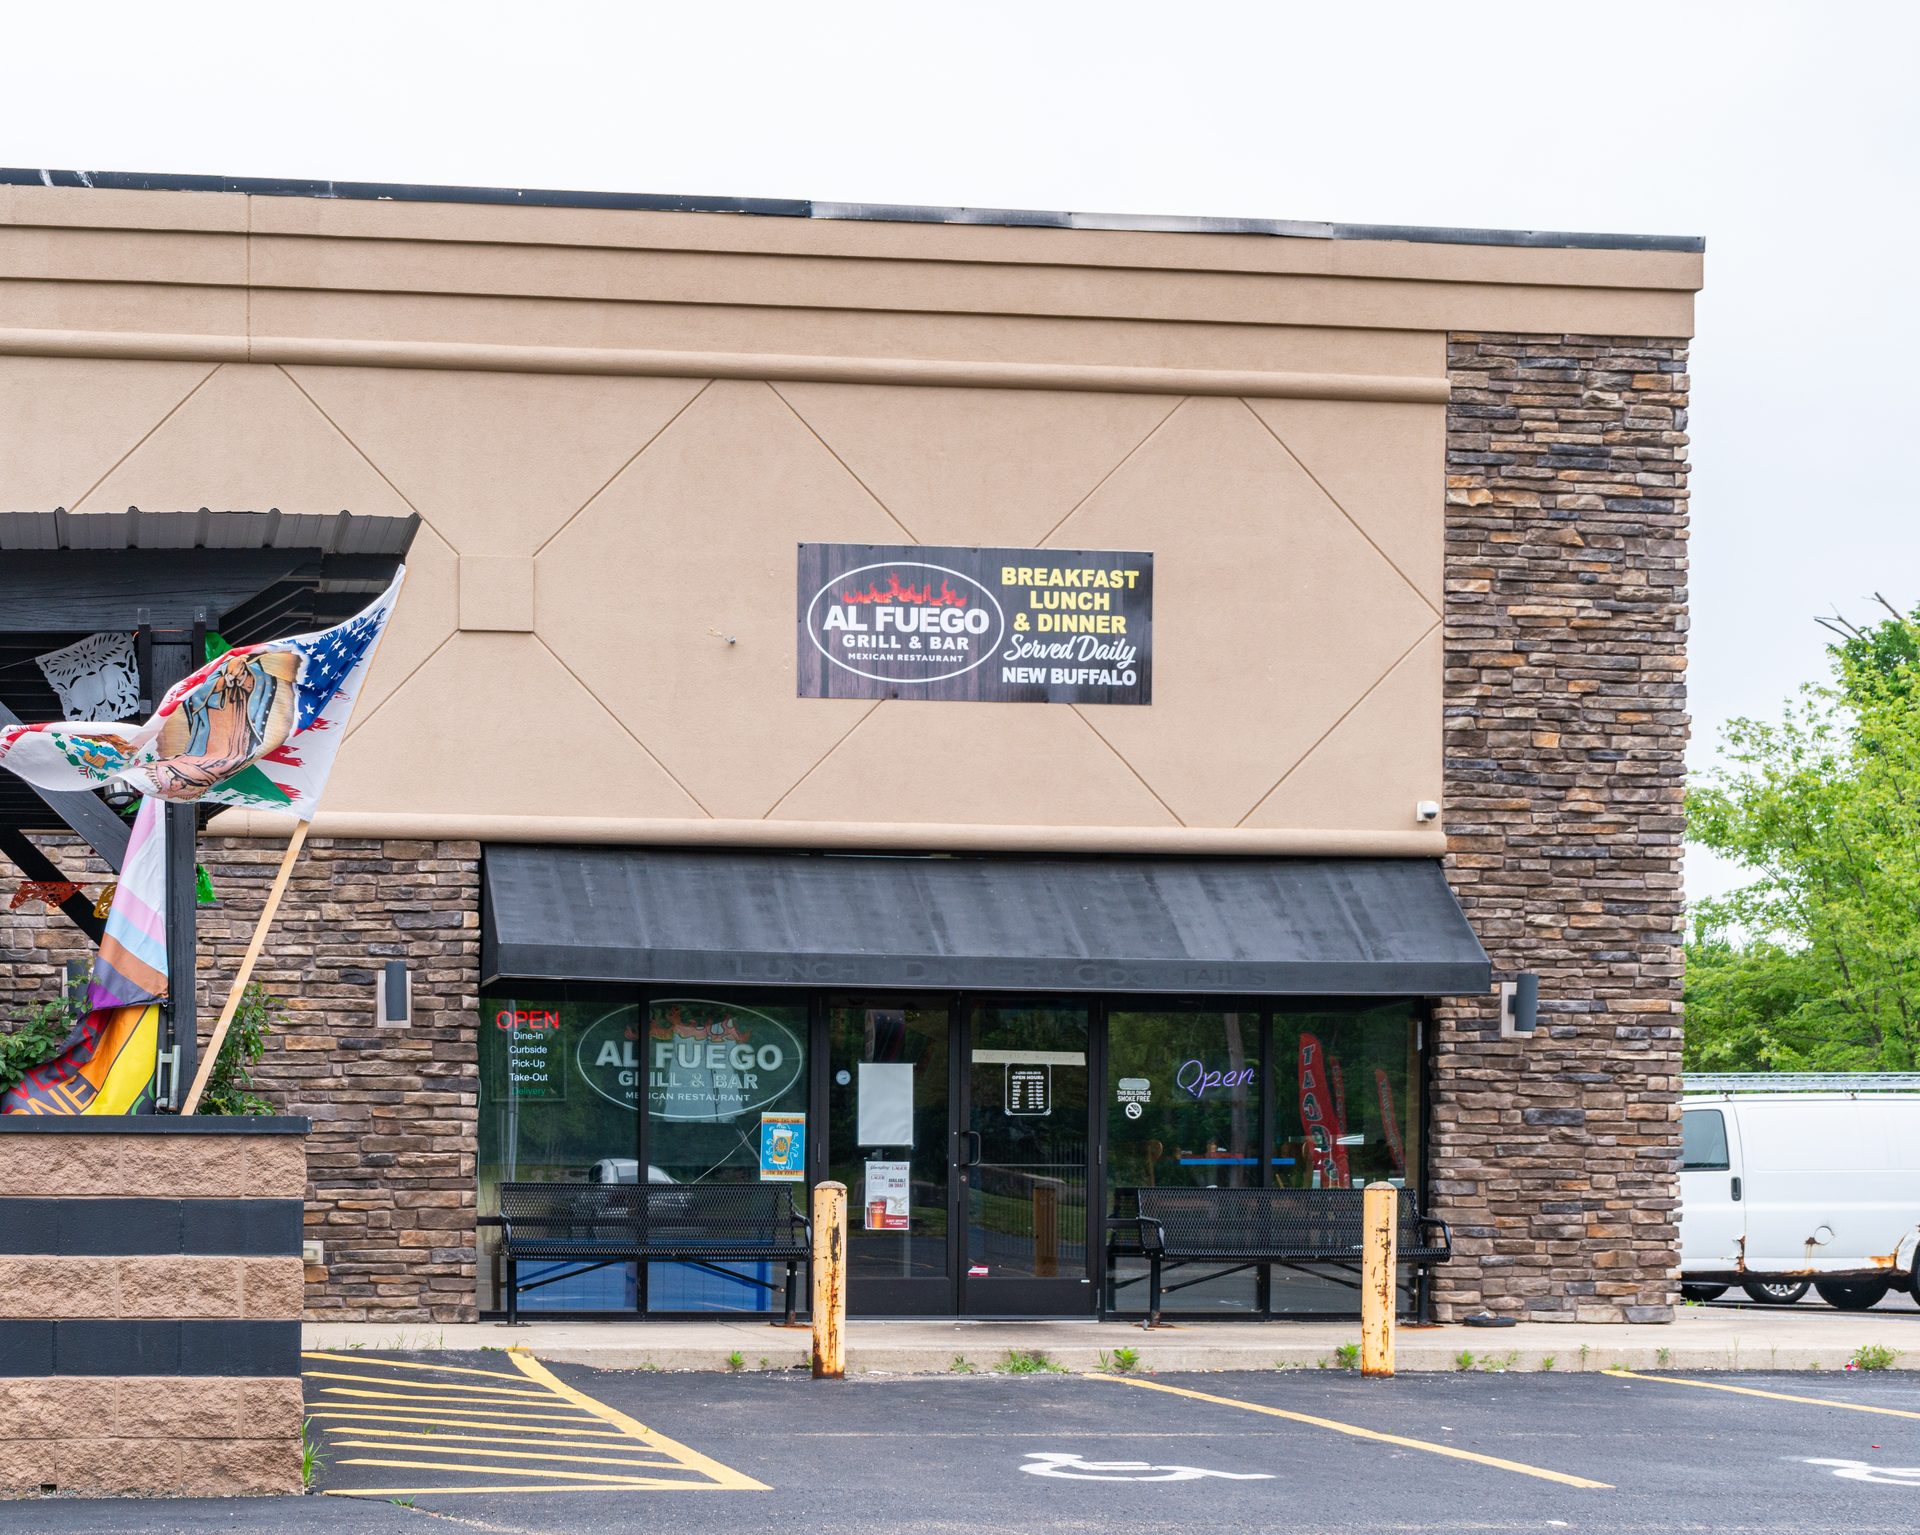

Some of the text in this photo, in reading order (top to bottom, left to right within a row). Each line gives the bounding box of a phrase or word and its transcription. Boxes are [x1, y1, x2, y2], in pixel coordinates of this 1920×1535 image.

[1001, 566, 1139, 589] BREAKFAST
[1030, 590, 1110, 611] LUNCH
[823, 605, 990, 635] AL FUEGO
[1014, 613, 1127, 634] & DINNER
[842, 634, 969, 650] GRILL & BAR
[1003, 634, 1136, 668] Served Daily
[848, 652, 964, 663] MEXICAN RESTAURANT
[1002, 667, 1137, 687] NEW BUFFALO
[736, 956, 859, 979] LUNCH
[496, 1010, 559, 1029] OPEN
[513, 1031, 544, 1040] Dine-In
[509, 1045, 548, 1054] Curbside
[595, 1040, 783, 1071] AL FUEGO
[511, 1059, 545, 1069] Pick-Up
[510, 1072, 549, 1081] Take-Out
[691, 1072, 705, 1088] &
[714, 1073, 759, 1090] BAR
[1177, 1060, 1255, 1098] Open
[10, 1075, 99, 1115] NE
[512, 1087, 545, 1096] Delivery
[626, 1091, 751, 1101] MEICAN RESTAURANT
